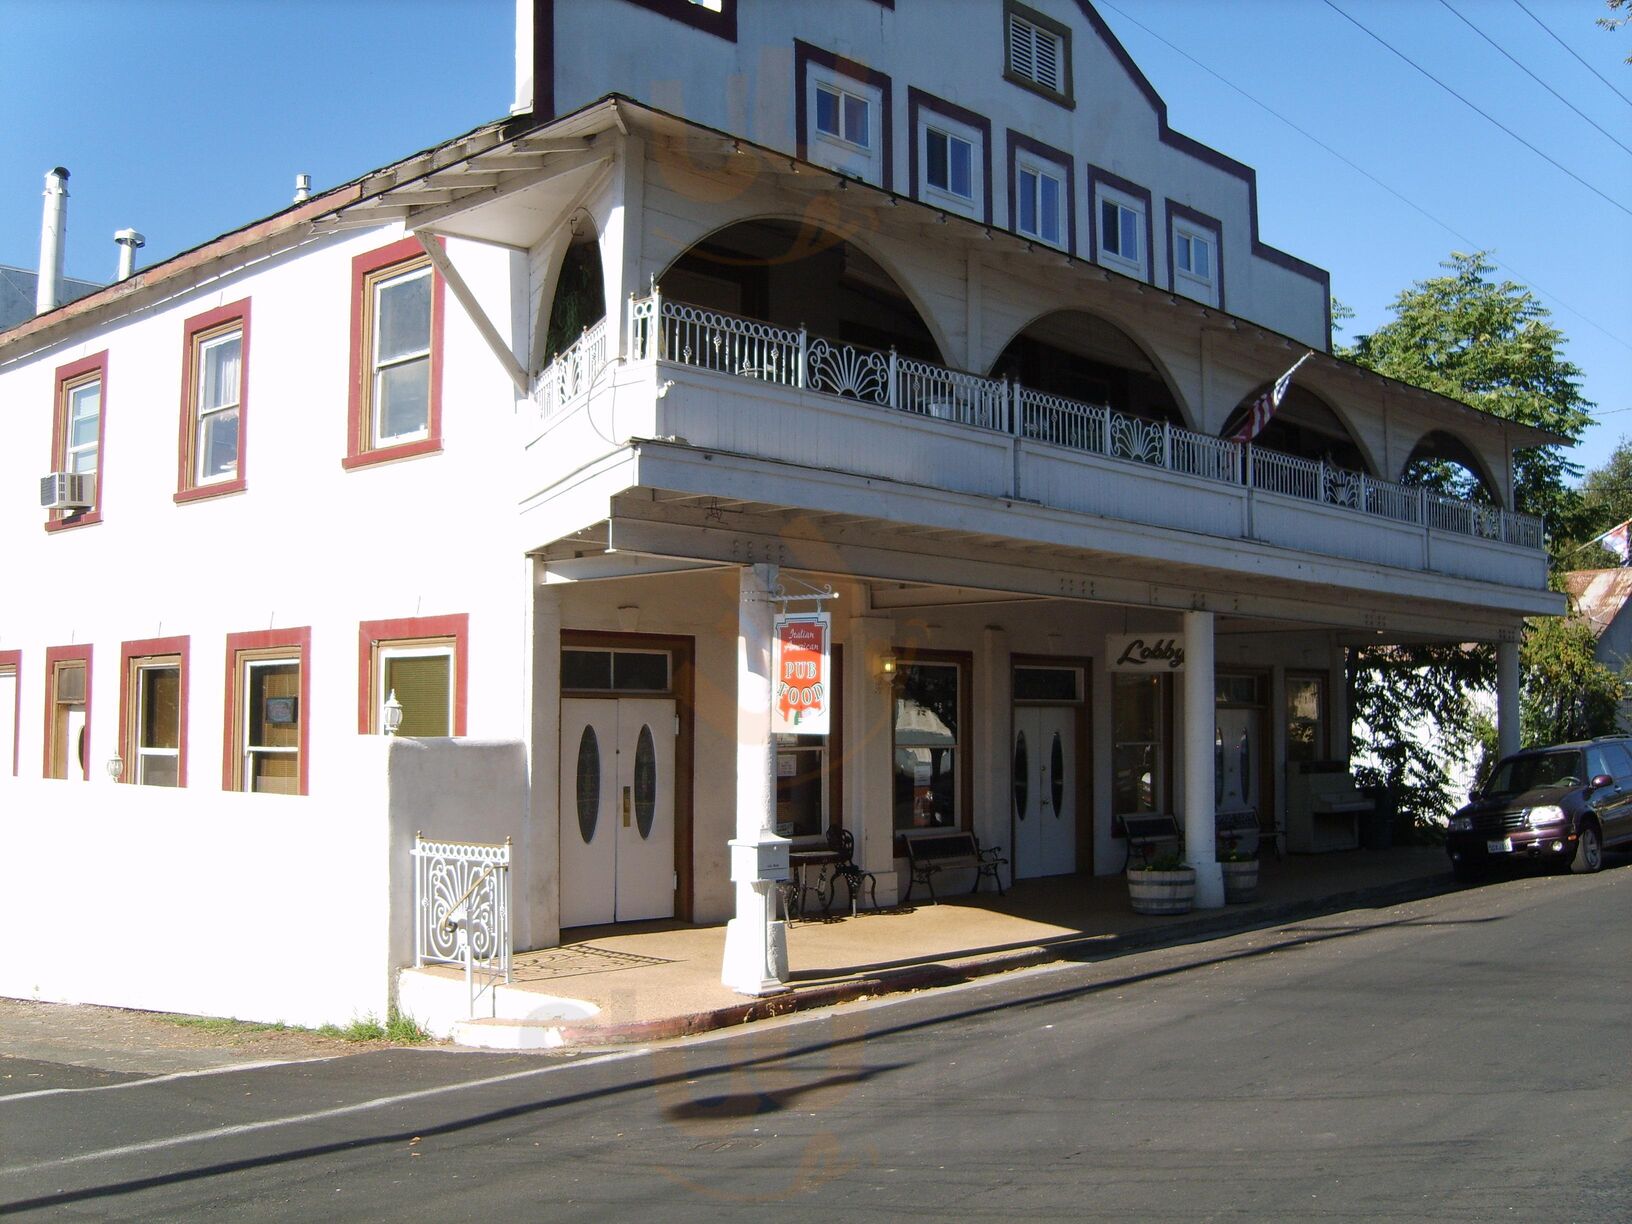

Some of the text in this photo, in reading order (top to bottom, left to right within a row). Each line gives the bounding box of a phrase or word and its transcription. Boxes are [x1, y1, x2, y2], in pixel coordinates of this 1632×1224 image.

[788, 628, 815, 639] Italian
[1116, 639, 1185, 668] Lobby
[785, 661, 817, 679] PUB
[777, 682, 824, 705] FOOD
